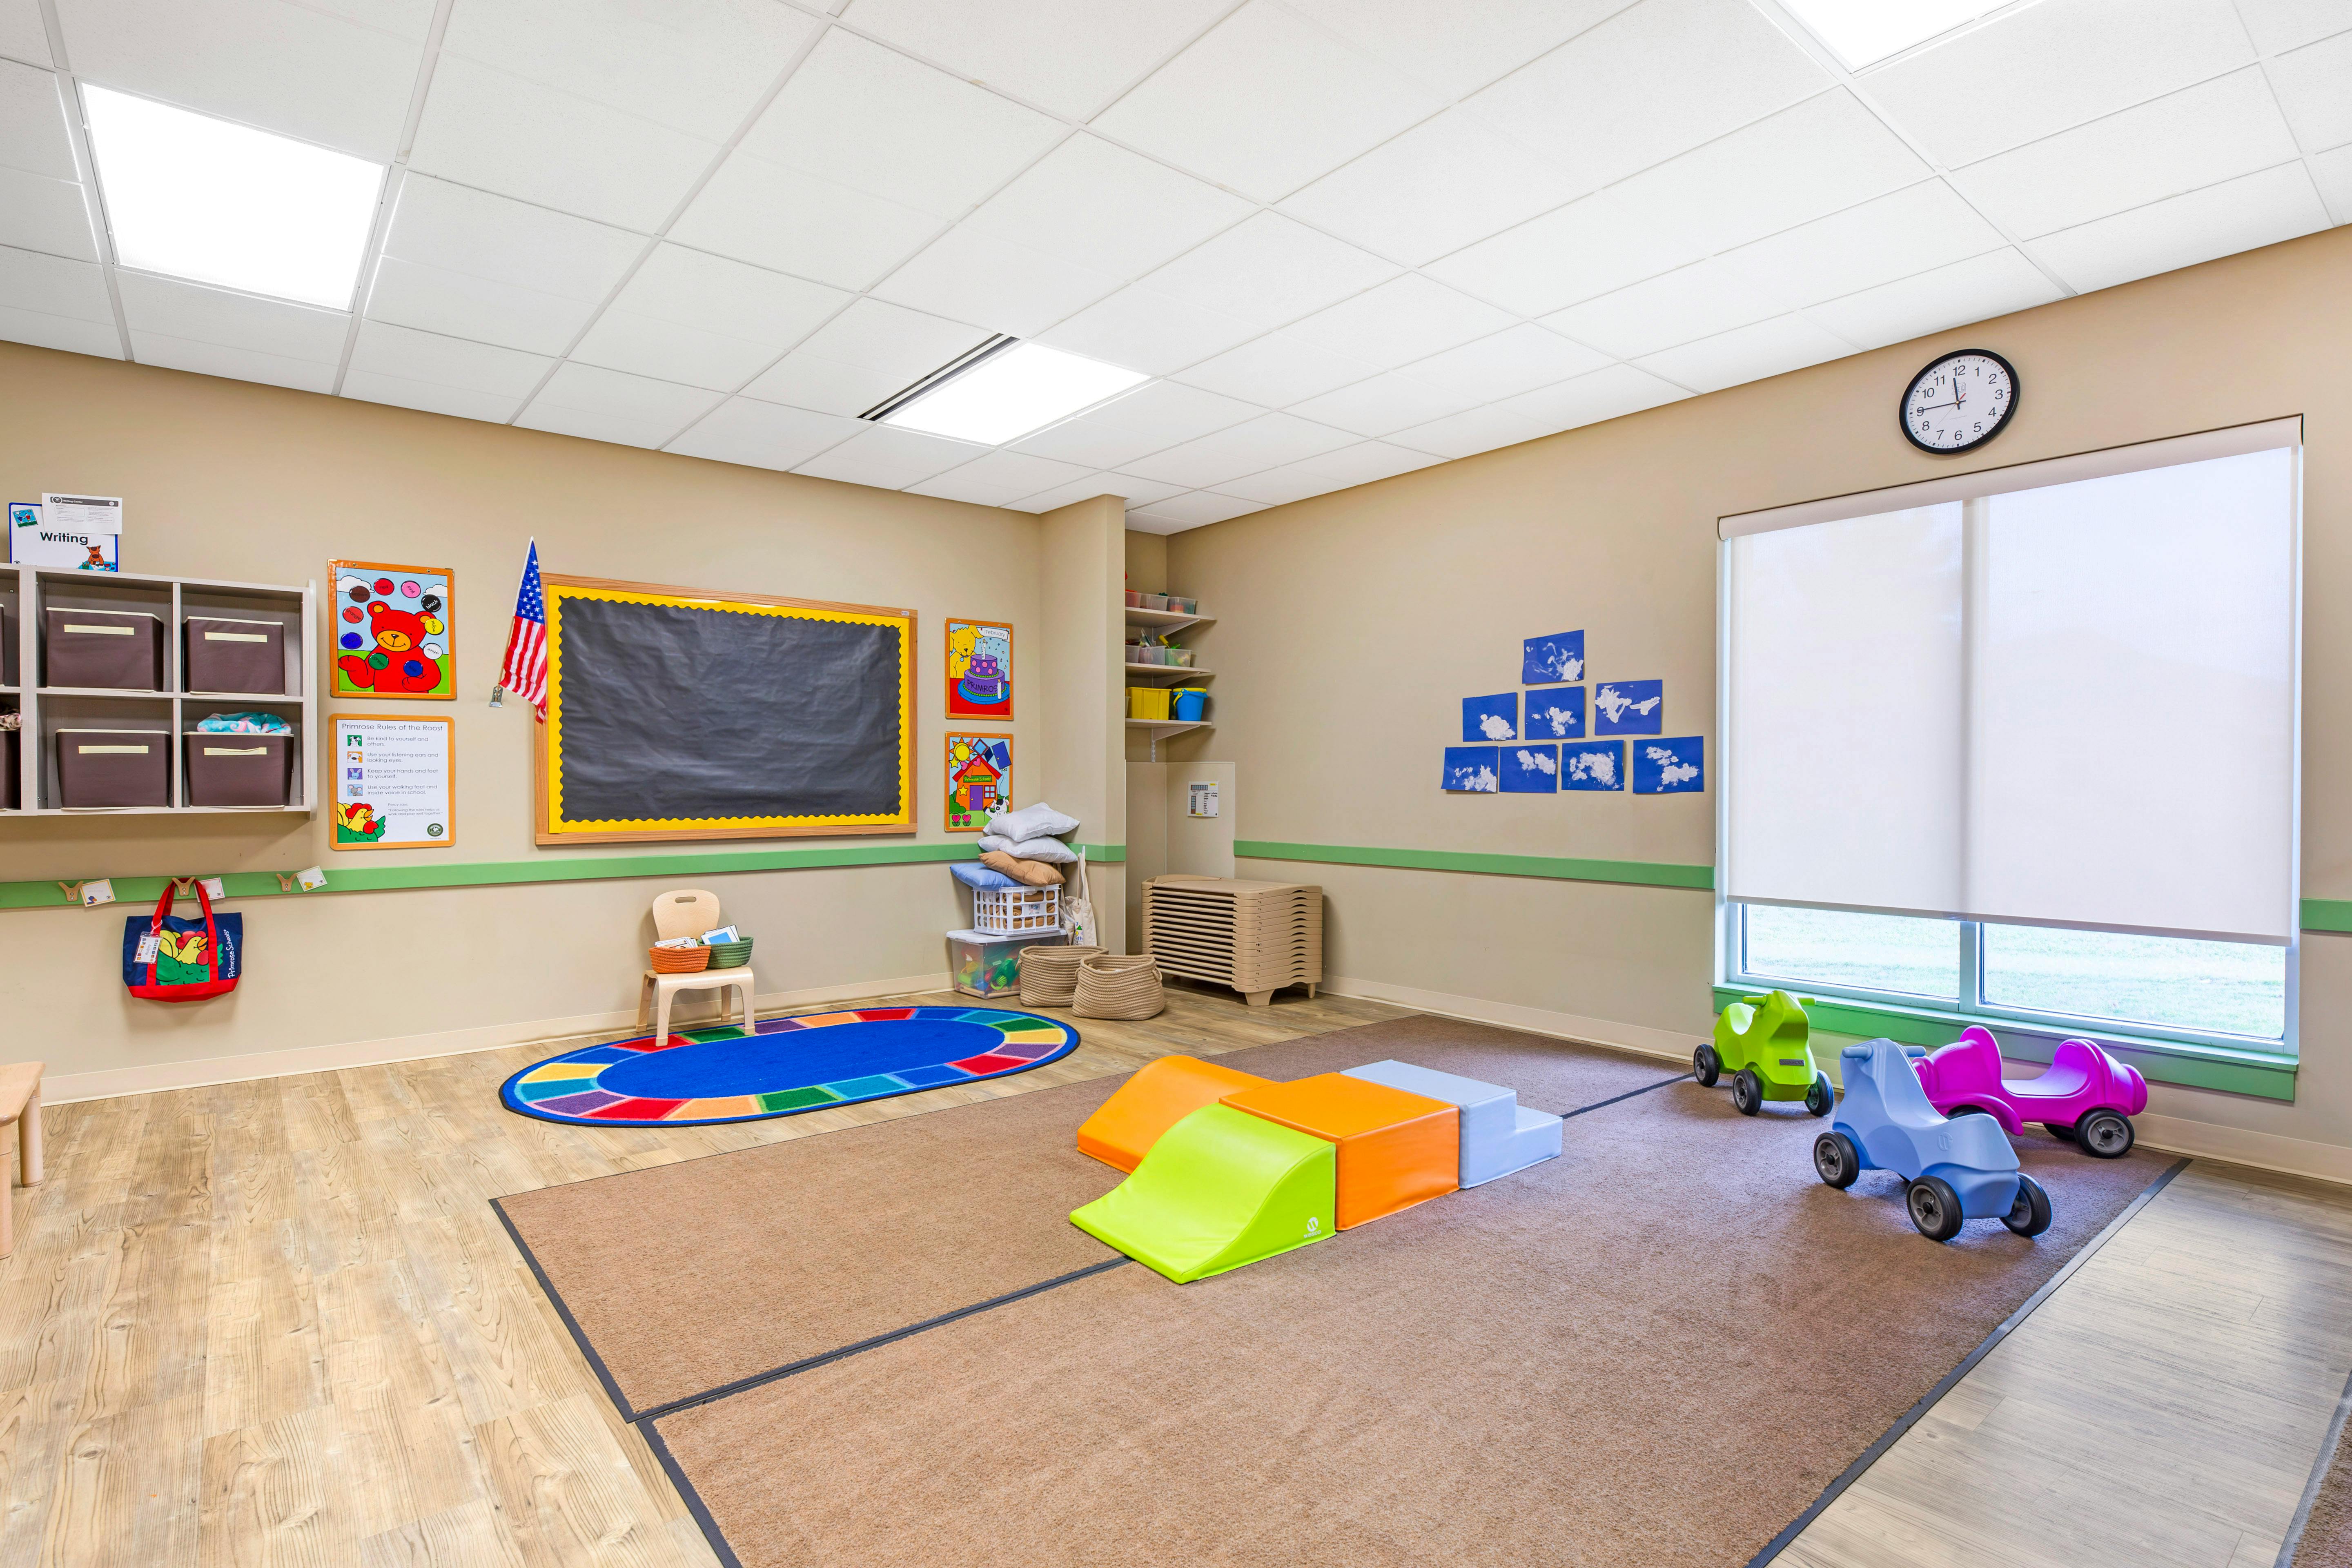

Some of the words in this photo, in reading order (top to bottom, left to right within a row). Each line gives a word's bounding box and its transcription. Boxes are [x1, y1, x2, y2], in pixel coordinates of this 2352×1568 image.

[1953, 365, 1966, 376] 12
[1975, 367, 1979, 376] 1
[1934, 375, 1945, 386] 11
[1988, 374, 1997, 384] 2
[1922, 388, 1934, 399] 10
[1995, 389, 2003, 400] 3
[1917, 407, 1924, 416] 9
[1988, 407, 1996, 417] 4
[1922, 421, 1930, 431] 8
[1973, 422, 1982, 432] 5
[1936, 430, 1944, 440] 7
[1954, 430, 1962, 440] 6
[40, 532, 88, 545] Writing
[406, 586, 415, 594] pink
[425, 599, 438, 609] black
[345, 608, 361, 621] orange
[372, 656, 385, 667] green
[967, 679, 998, 693] PRIMROS
